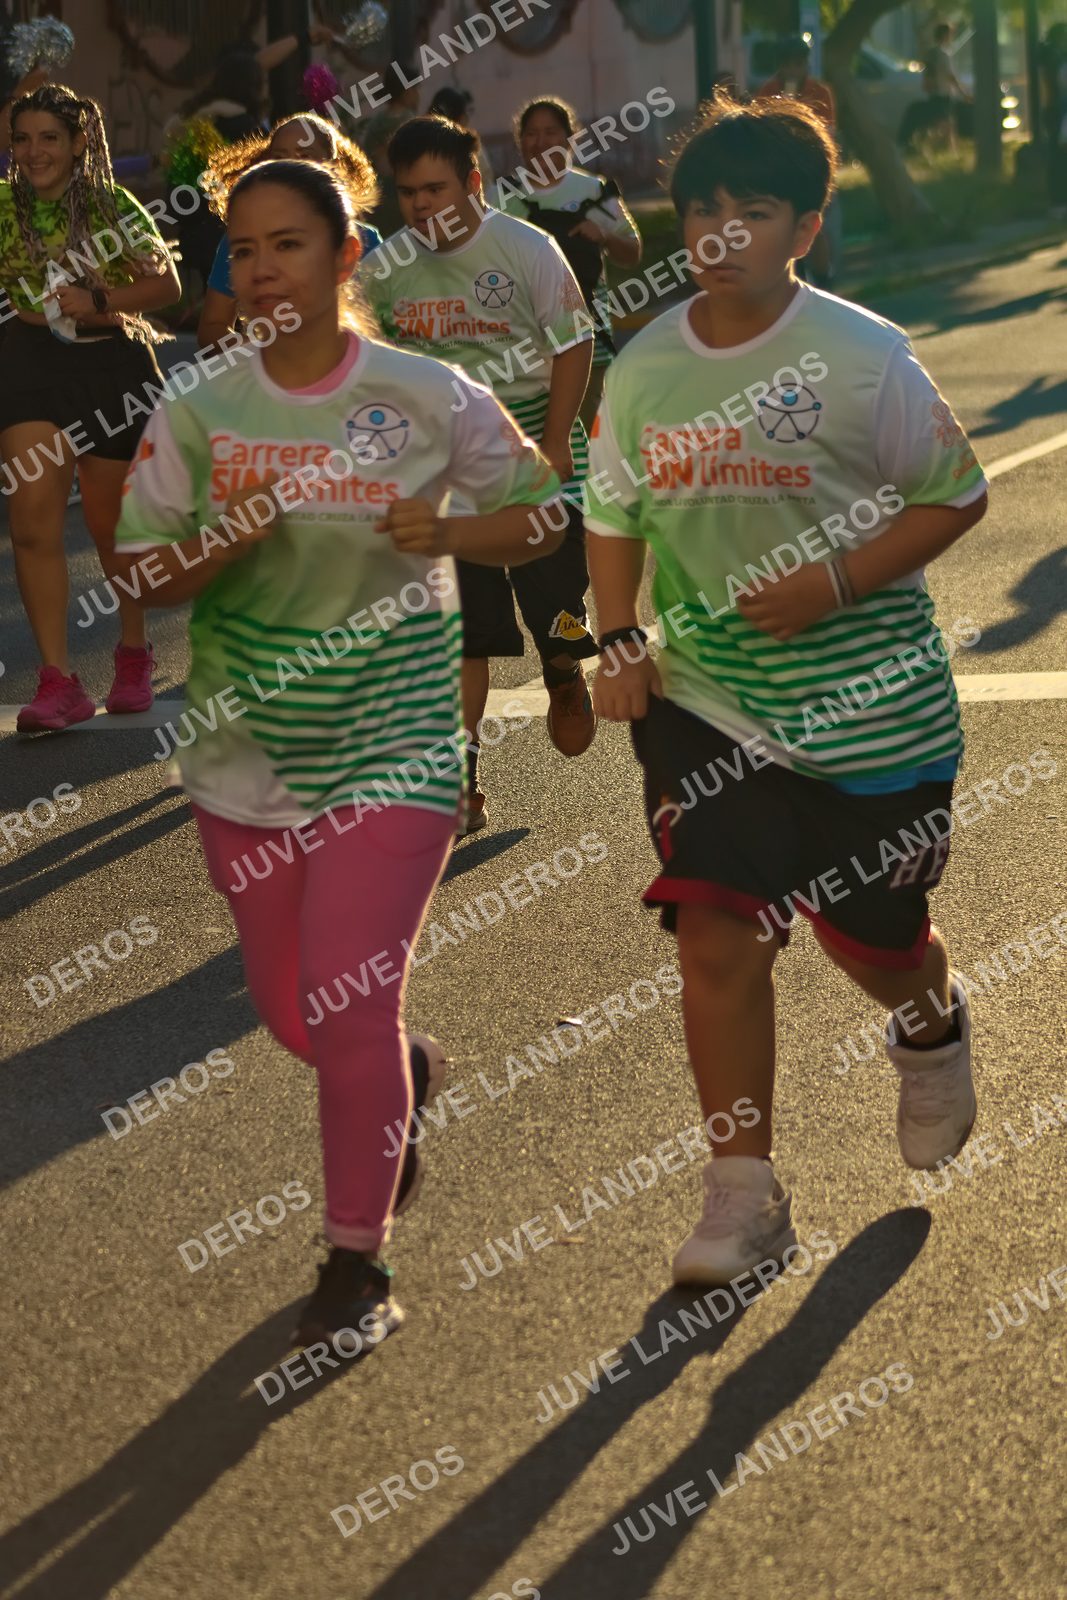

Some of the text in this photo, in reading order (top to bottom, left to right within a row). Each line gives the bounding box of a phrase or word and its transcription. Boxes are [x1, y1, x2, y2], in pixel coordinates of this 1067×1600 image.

[393, 299, 466, 318] Carrera
[395, 318, 435, 340] SIN
[210, 435, 332, 467] Carrera
[640, 427, 742, 457] Carrera
[700, 455, 813, 488] límites
